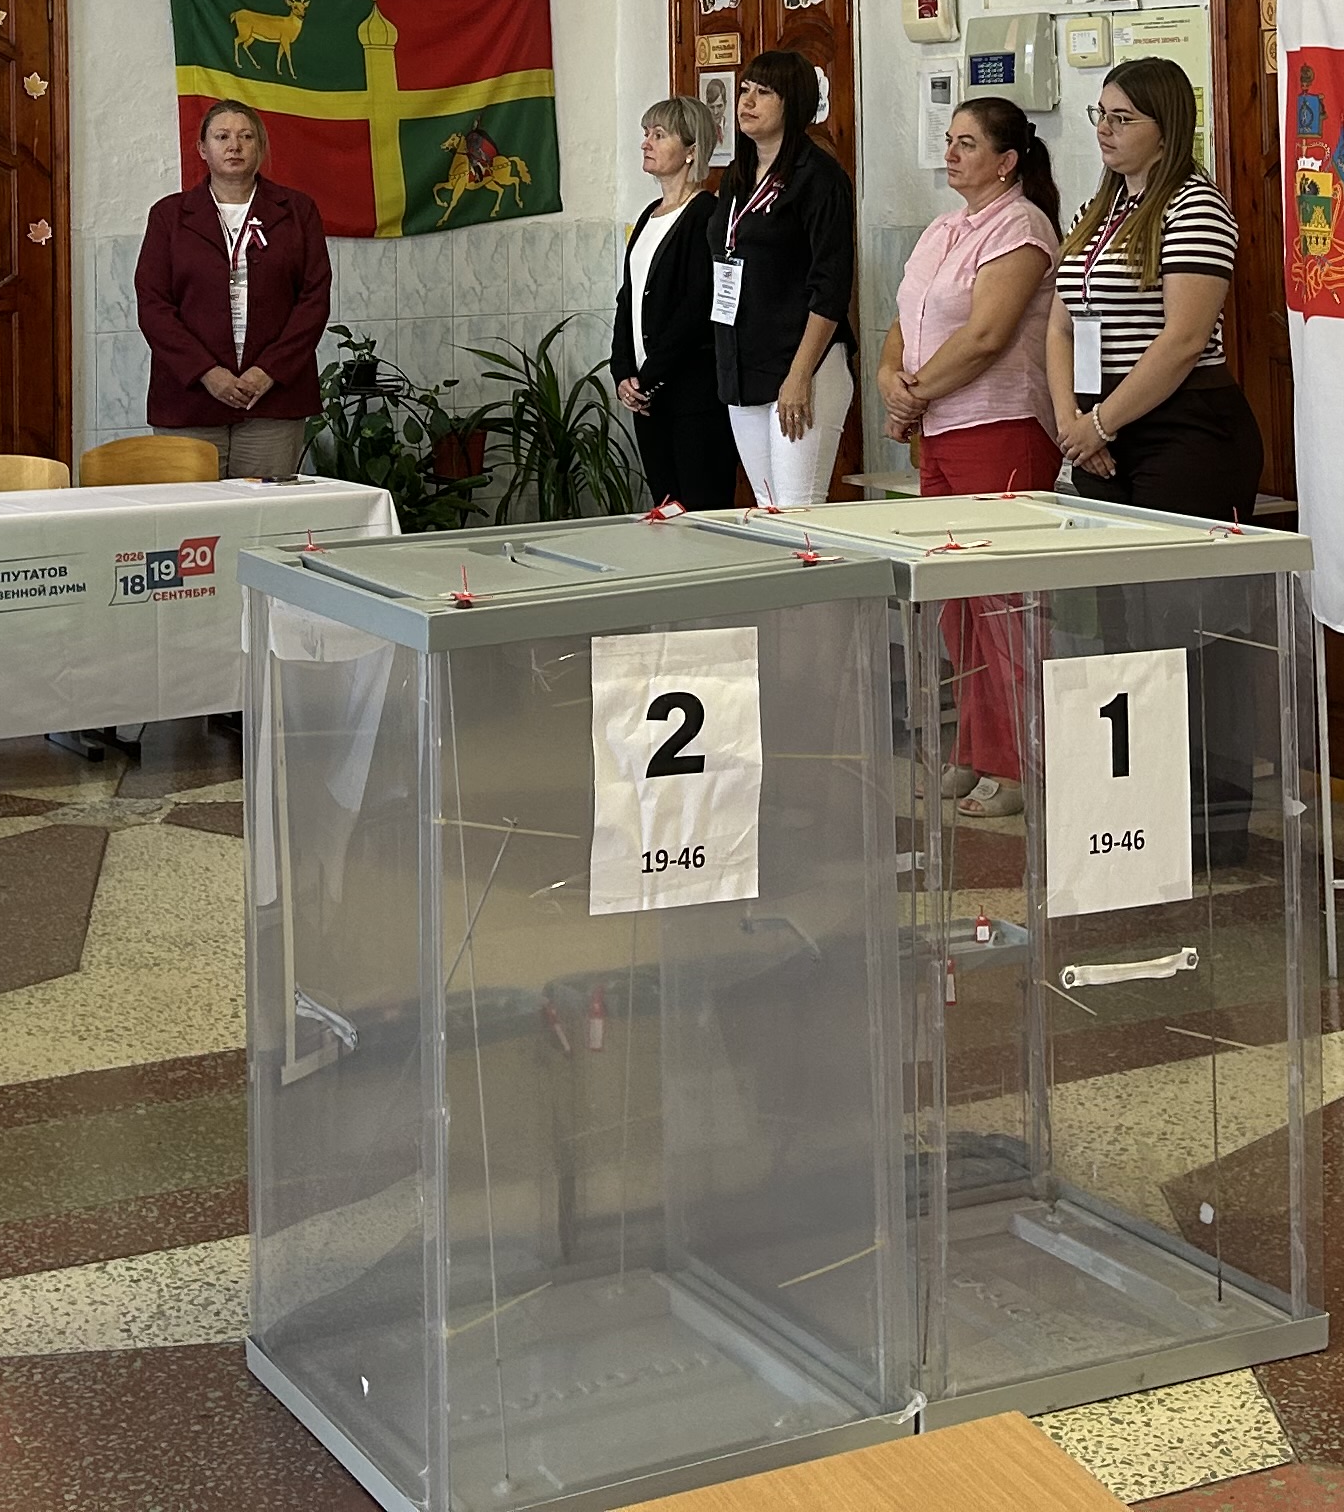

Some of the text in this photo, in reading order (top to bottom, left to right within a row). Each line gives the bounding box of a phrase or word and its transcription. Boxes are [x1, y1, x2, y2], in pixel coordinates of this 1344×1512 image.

[181, 546, 212, 568] 20
[150, 559, 176, 581] 19
[49, 582, 87, 597] ДУМЫ
[119, 574, 145, 596] 18
[153, 586, 216, 602] СЕНТЯБРЯ
[645, 691, 706, 779] 2
[1099, 692, 1130, 778] 1
[1089, 829, 1145, 856] 19-46
[641, 845, 706, 875] 19-46
